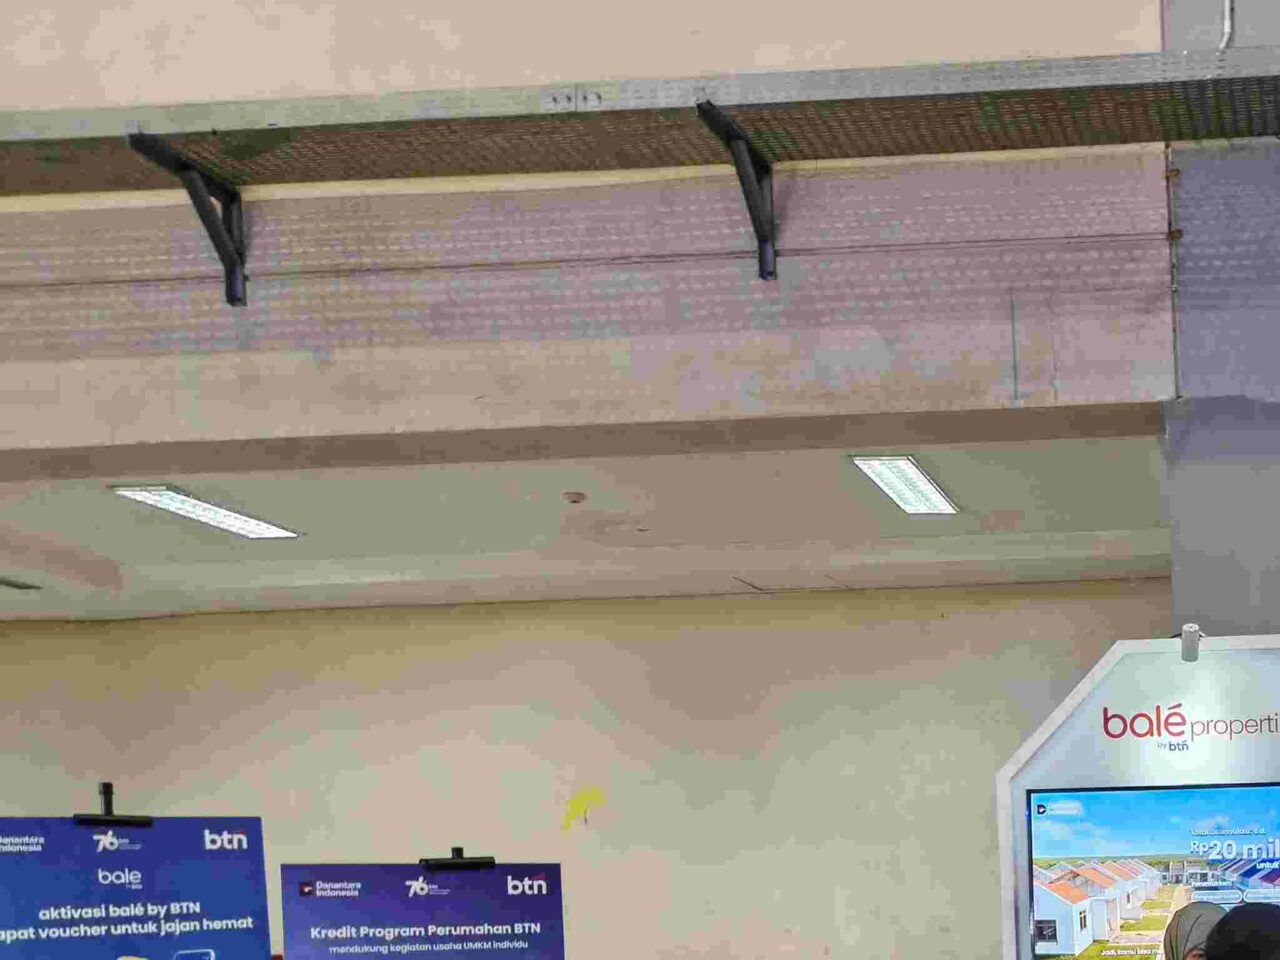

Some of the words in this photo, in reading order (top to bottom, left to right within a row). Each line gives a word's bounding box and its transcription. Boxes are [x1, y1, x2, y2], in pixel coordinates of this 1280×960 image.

[1102, 702, 1187, 739] balé
[1190, 712, 1280, 742] properti
[93, 830, 119, 852] 76
[204, 829, 248, 850] btn
[316, 881, 361, 890] Danantara
[316, 889, 359, 898] Indonesia
[405, 876, 429, 898] 76
[507, 875, 548, 895] btn
[39, 906, 106, 921] aktivasi
[108, 902, 145, 918] balé
[147, 903, 168, 920] by
[170, 901, 200, 915] BTN
[0, 926, 36, 944] apat
[38, 921, 109, 938] voucher
[111, 918, 158, 935] untuk
[160, 918, 200, 936] jajan
[203, 916, 254, 931] hemat
[310, 926, 356, 940] Kredit
[359, 926, 426, 941] Program
[428, 923, 512, 936] Perumahan
[514, 922, 541, 934] BTN
[390, 942, 431, 953] kegiatan
[463, 941, 492, 950] UMKM
[493, 940, 529, 949] individu
